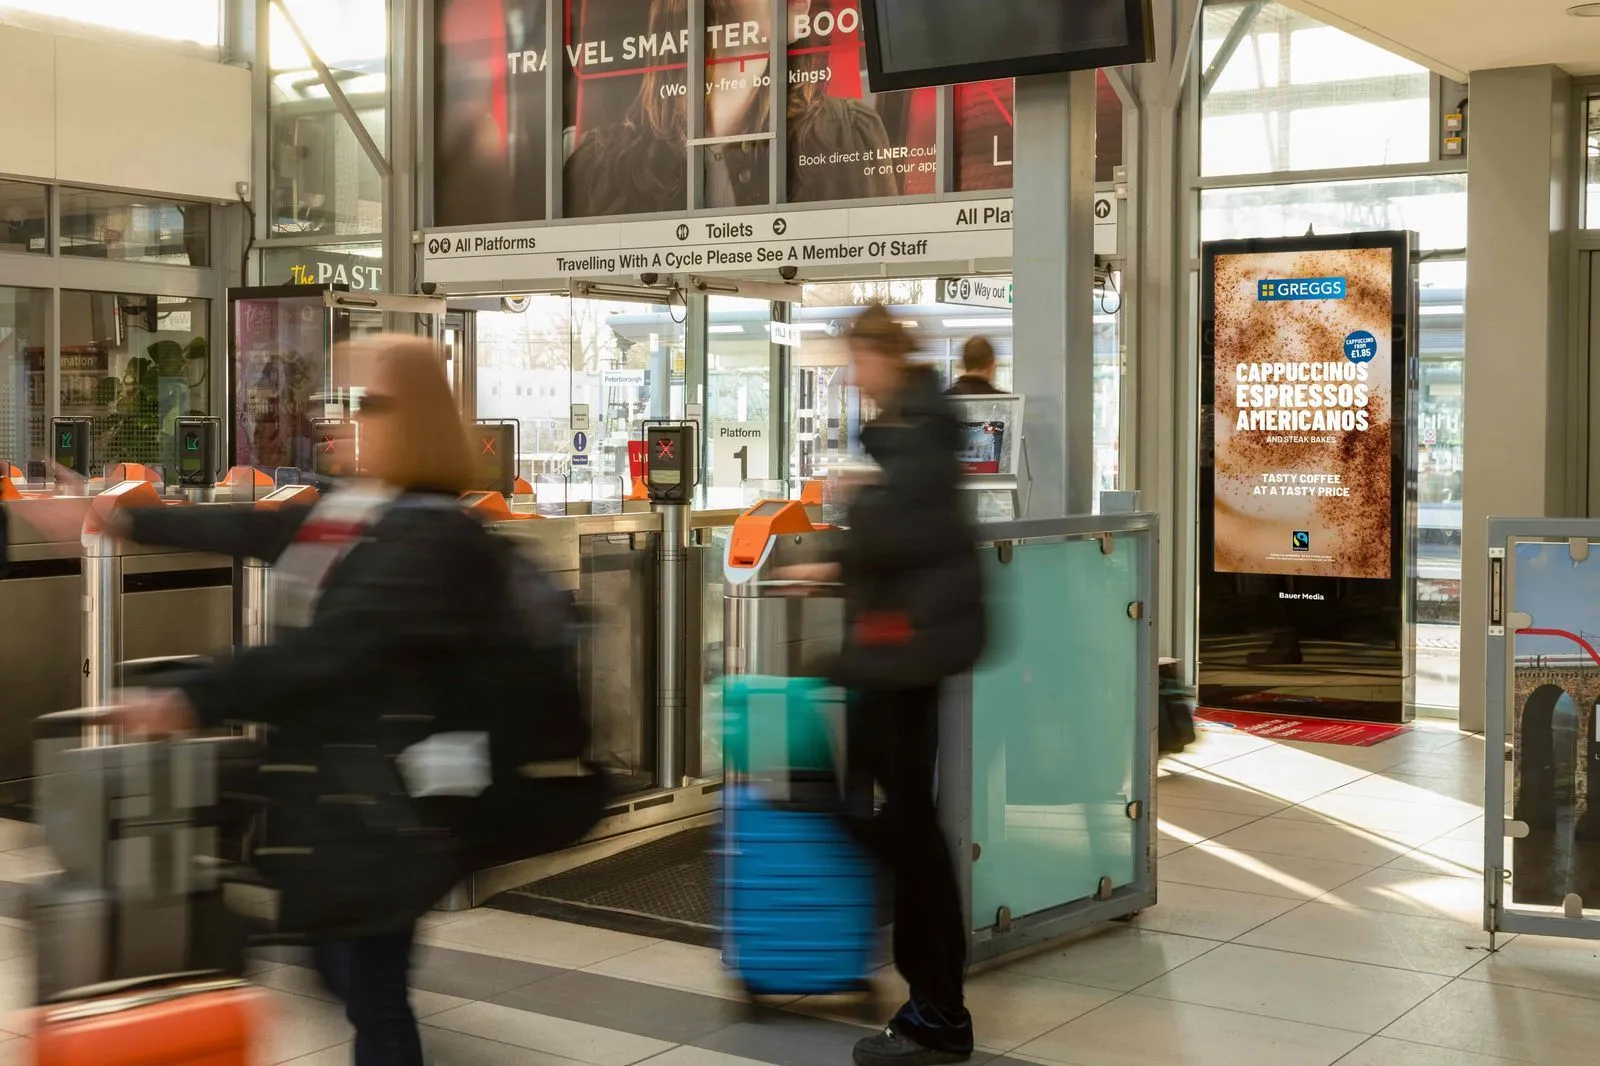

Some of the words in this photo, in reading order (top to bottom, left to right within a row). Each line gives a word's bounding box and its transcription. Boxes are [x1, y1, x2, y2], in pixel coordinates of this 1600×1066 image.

[794, 7, 864, 40] BOO
[660, 77, 746, 100] (Woy-free
[753, 66, 832, 88] bokings)
[799, 153, 827, 166] Book
[829, 151, 860, 164] direct
[863, 151, 874, 161] at
[863, 165, 875, 176] or
[878, 164, 893, 175] on
[896, 163, 915, 173] our
[956, 208, 978, 225] All
[705, 222, 753, 239] Toilets
[455, 238, 471, 252] All
[474, 236, 536, 252] Platforms
[556, 256, 615, 272] Travelling
[619, 253, 648, 269] With
[651, 253, 662, 267] A
[665, 250, 703, 268] Cycle
[706, 249, 753, 265] Please
[756, 248, 784, 262] See
[787, 246, 798, 260] A
[802, 244, 864, 260] Member
[868, 241, 886, 257] Of
[890, 239, 928, 256] Staff
[290, 264, 315, 285] the
[316, 262, 383, 291] PAST
[974, 282, 992, 298] Way
[992, 285, 1005, 299] out
[1277, 281, 1341, 296] GREGGS
[39, 355, 94, 367] Imation
[1350, 348, 1371, 359] £1.85
[1236, 361, 1369, 382] CAPPUCCINOS
[604, 375, 642, 385] Peterborough
[1236, 383, 1369, 408] ESPRESSOS
[1236, 409, 1369, 432] AMERICANOS
[720, 427, 761, 438] Platform
[1310, 436, 1337, 444] BAKES
[733, 445, 748, 480] 1
[1262, 473, 1296, 484] TASTY
[1299, 474, 1341, 484] COFFEE
[1253, 485, 1269, 496] AT
[1269, 486, 1277, 496] A
[1281, 486, 1316, 496] TASTY
[1318, 487, 1350, 497] PRICE
[1278, 591, 1301, 600] Bauer
[1301, 592, 1325, 601] Media
[82, 657, 91, 678] 4
